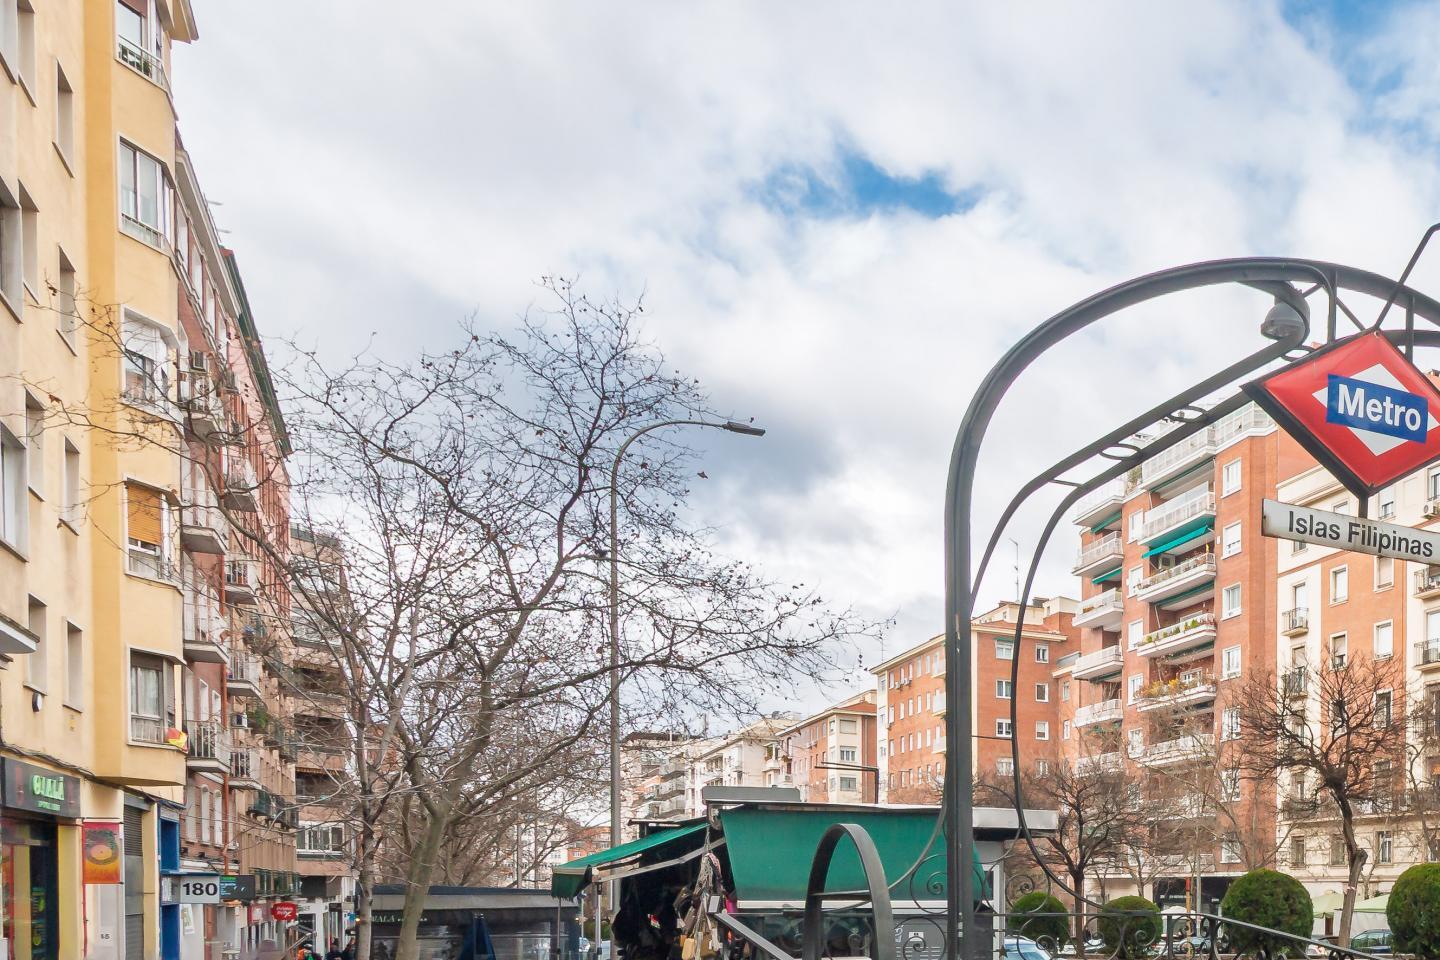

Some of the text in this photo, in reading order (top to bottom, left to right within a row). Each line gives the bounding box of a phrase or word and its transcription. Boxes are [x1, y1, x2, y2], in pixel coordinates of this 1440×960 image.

[1337, 383, 1422, 432] Metro
[1288, 510, 1433, 558] Islas Filipinas
[182, 882, 218, 896] 180
